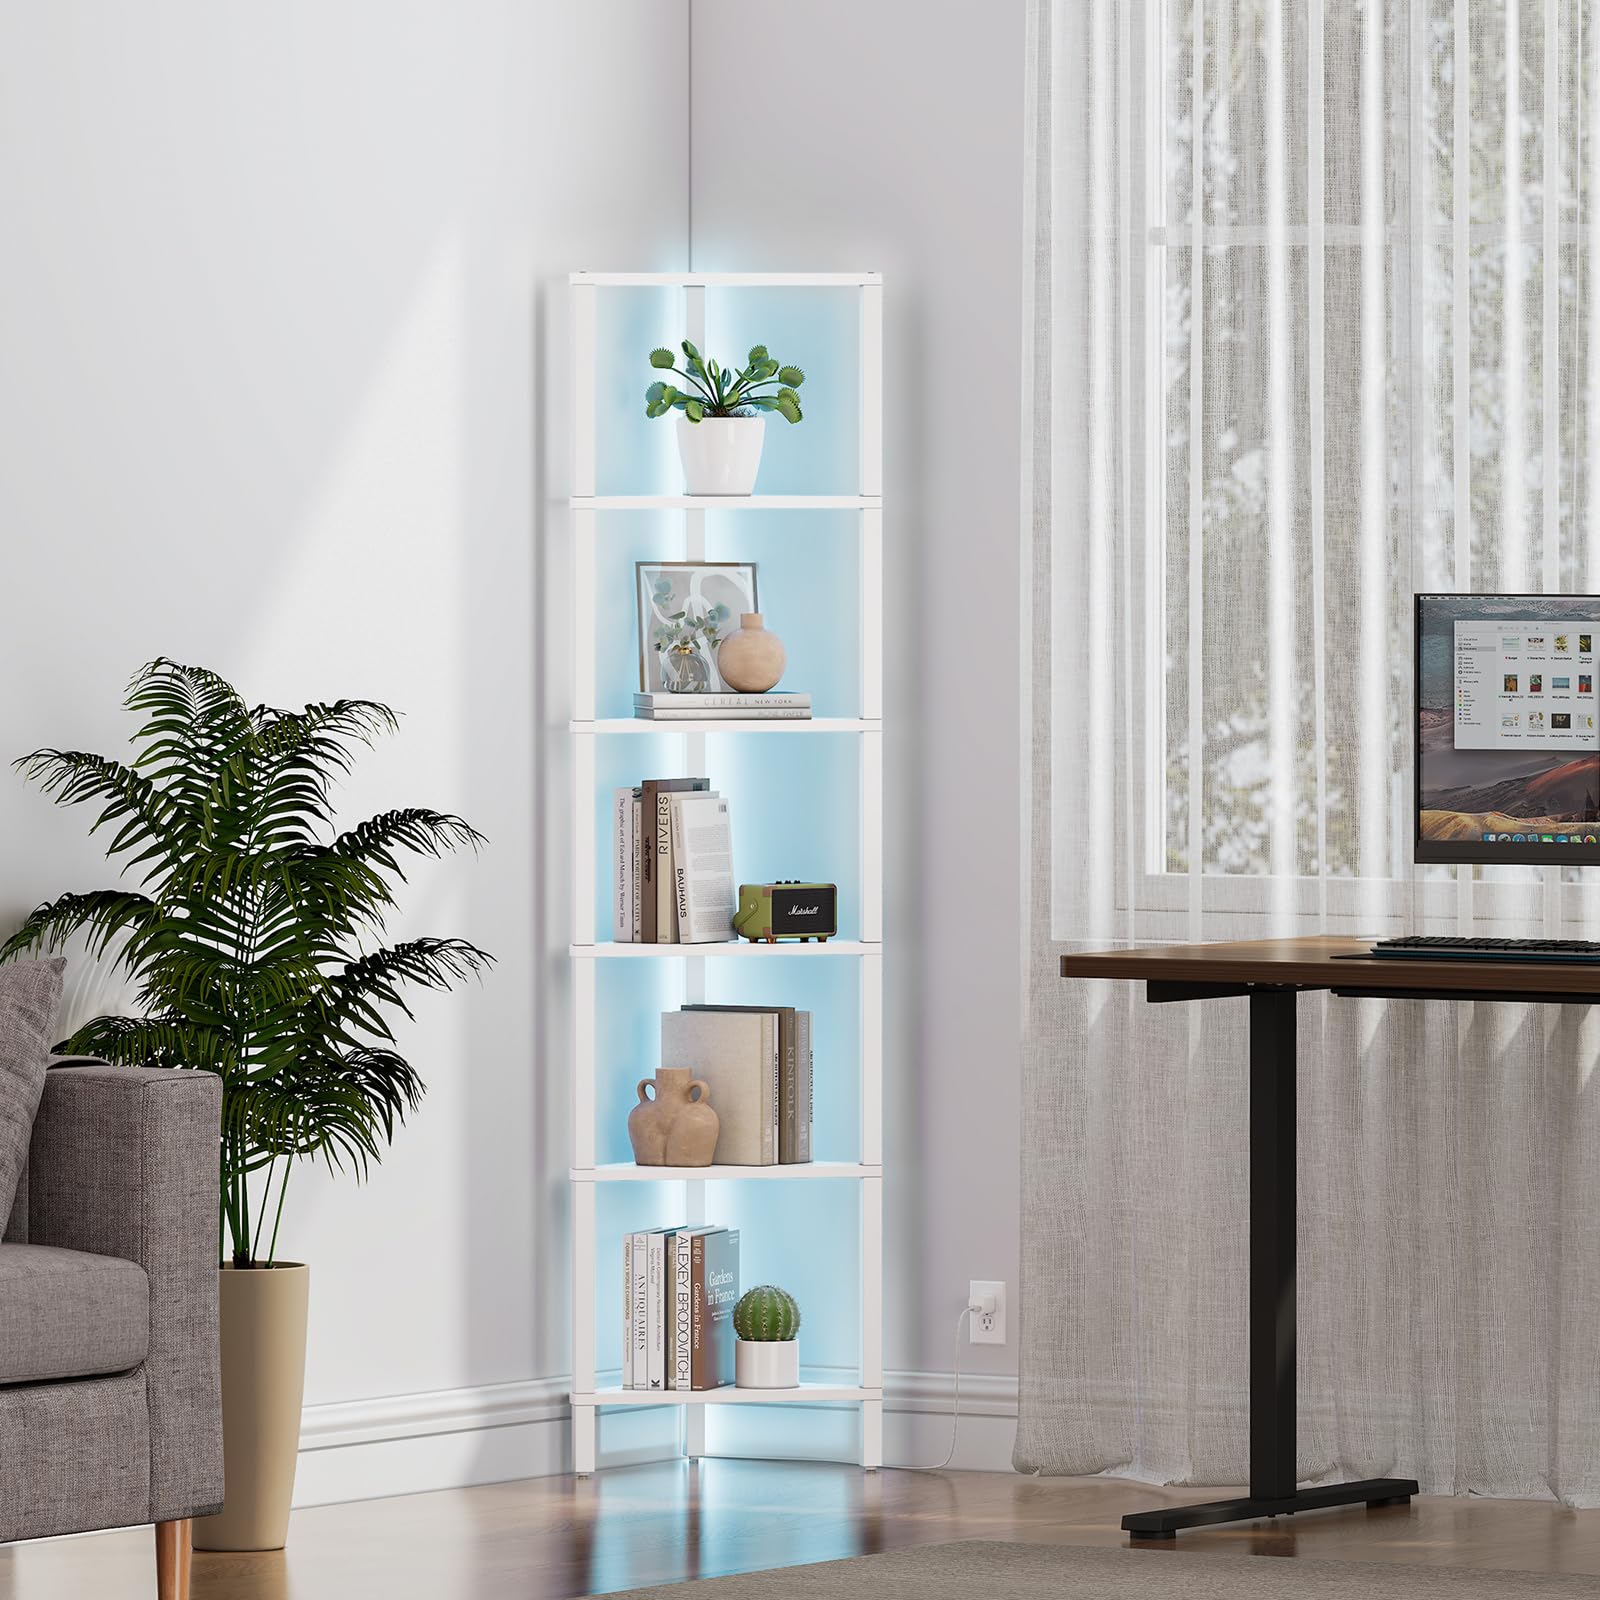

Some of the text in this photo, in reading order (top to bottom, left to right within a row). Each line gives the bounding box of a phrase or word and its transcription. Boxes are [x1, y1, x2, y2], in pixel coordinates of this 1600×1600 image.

[704, 697, 749, 706] CEREAL
[618, 809, 626, 830] graphic
[658, 796, 669, 855] RIVERS
[676, 868, 687, 918] BAUHAUS
[788, 905, 819, 916] Marshall
[678, 1236, 689, 1289] ALEXEY
[709, 1270, 734, 1287] Gardens
[637, 1274, 645, 1350] ANTIQUAIRES
[707, 1288, 735, 1306] in France
[678, 1292, 689, 1380] BRODOVITCH
